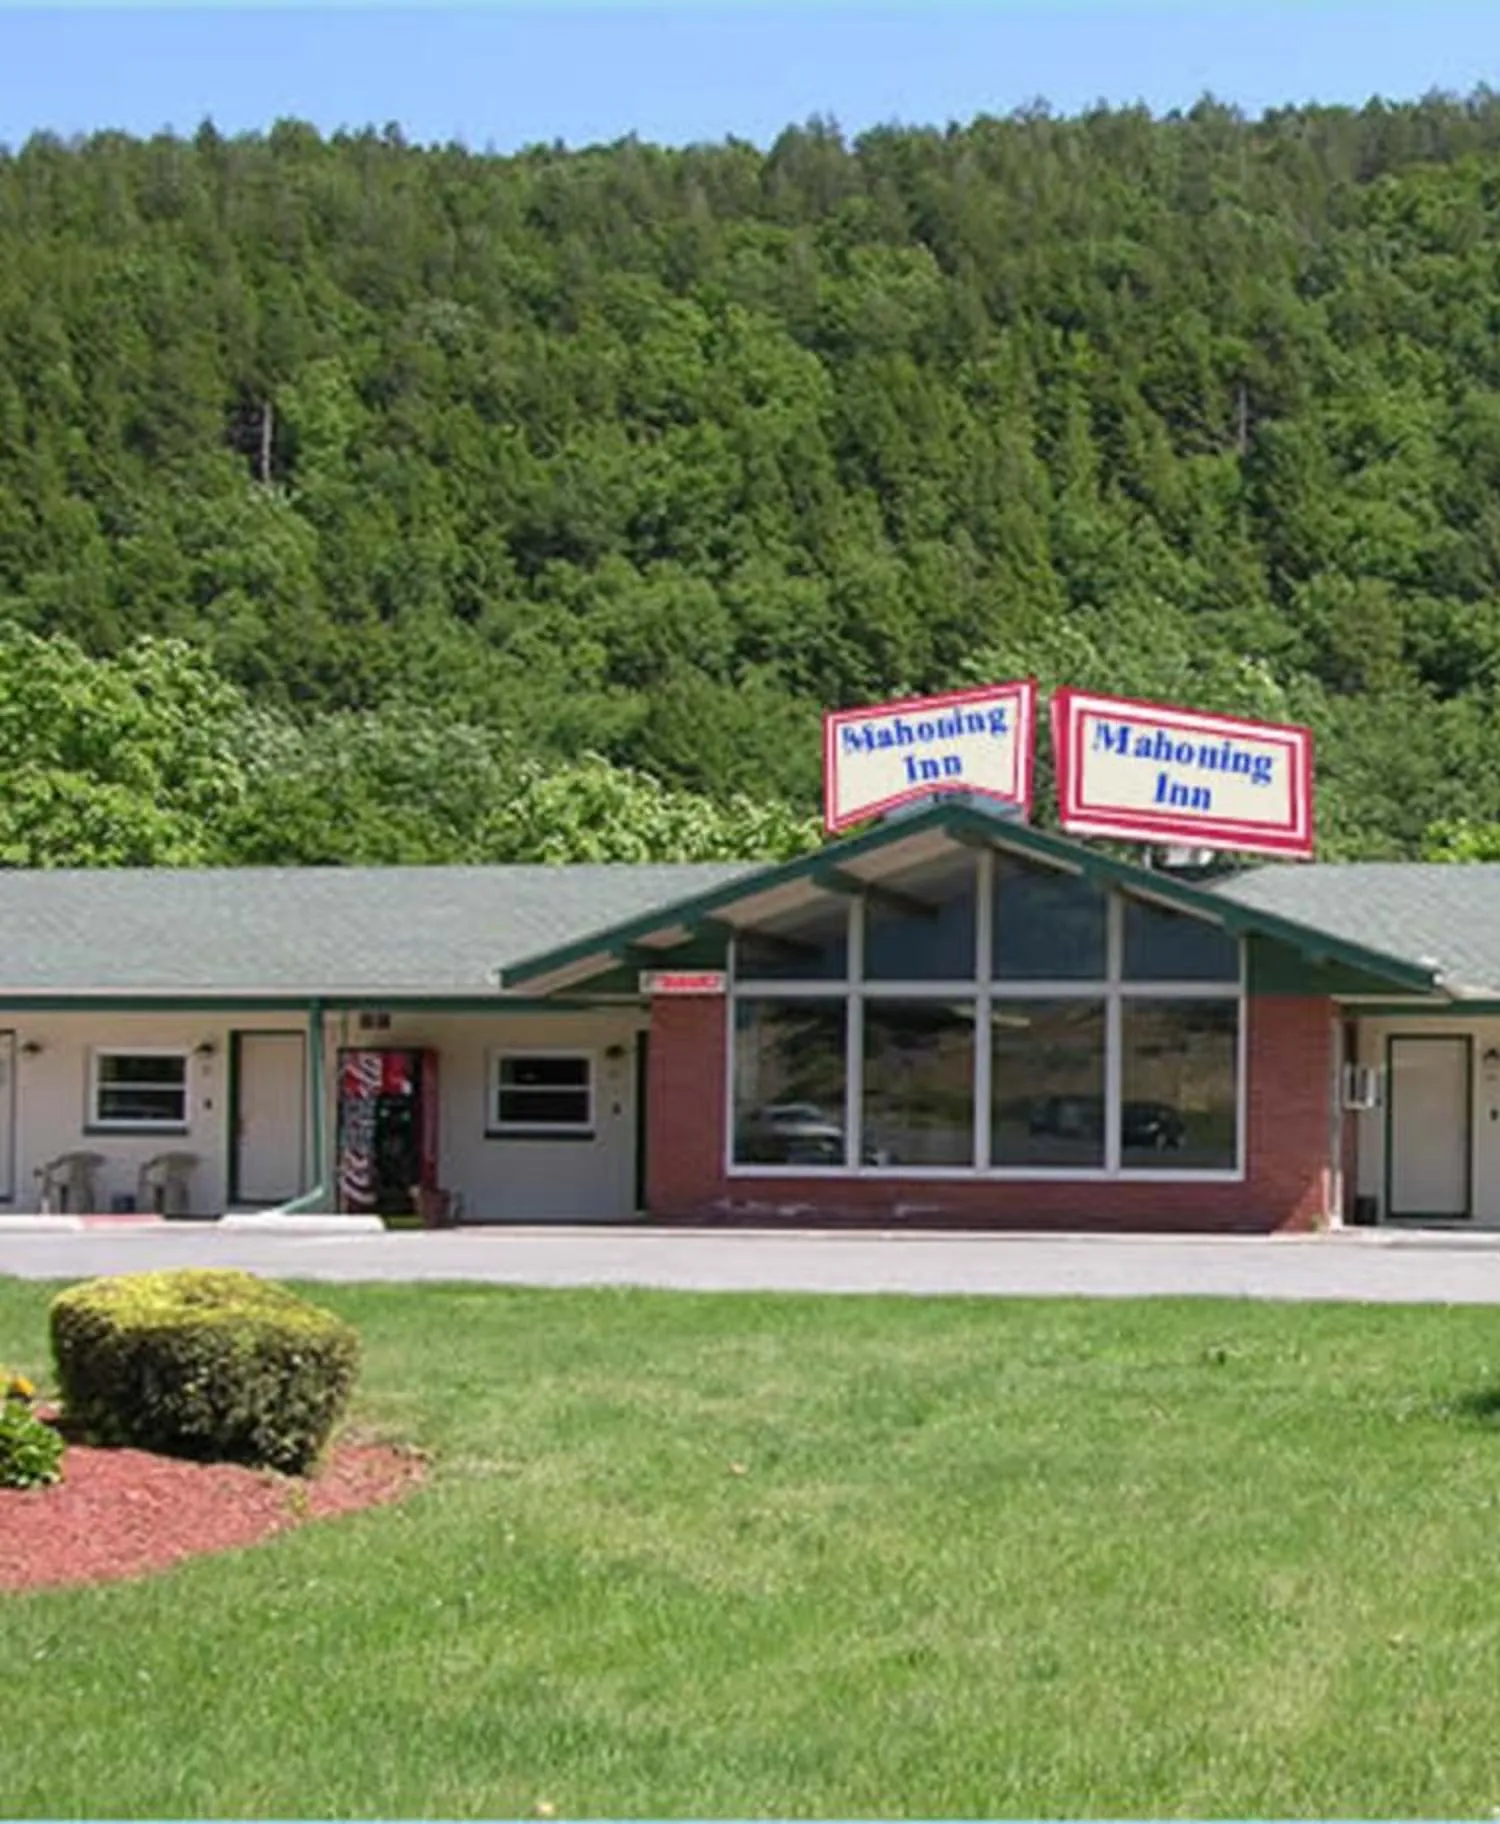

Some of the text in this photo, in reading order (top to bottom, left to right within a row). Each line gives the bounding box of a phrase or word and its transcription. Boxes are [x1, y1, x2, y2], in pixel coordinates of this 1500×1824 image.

[842, 707, 1008, 754] Mahoning
[903, 753, 963, 782] Inn
[1092, 723, 1274, 785] Mahoning
[1152, 772, 1213, 811] Inn
